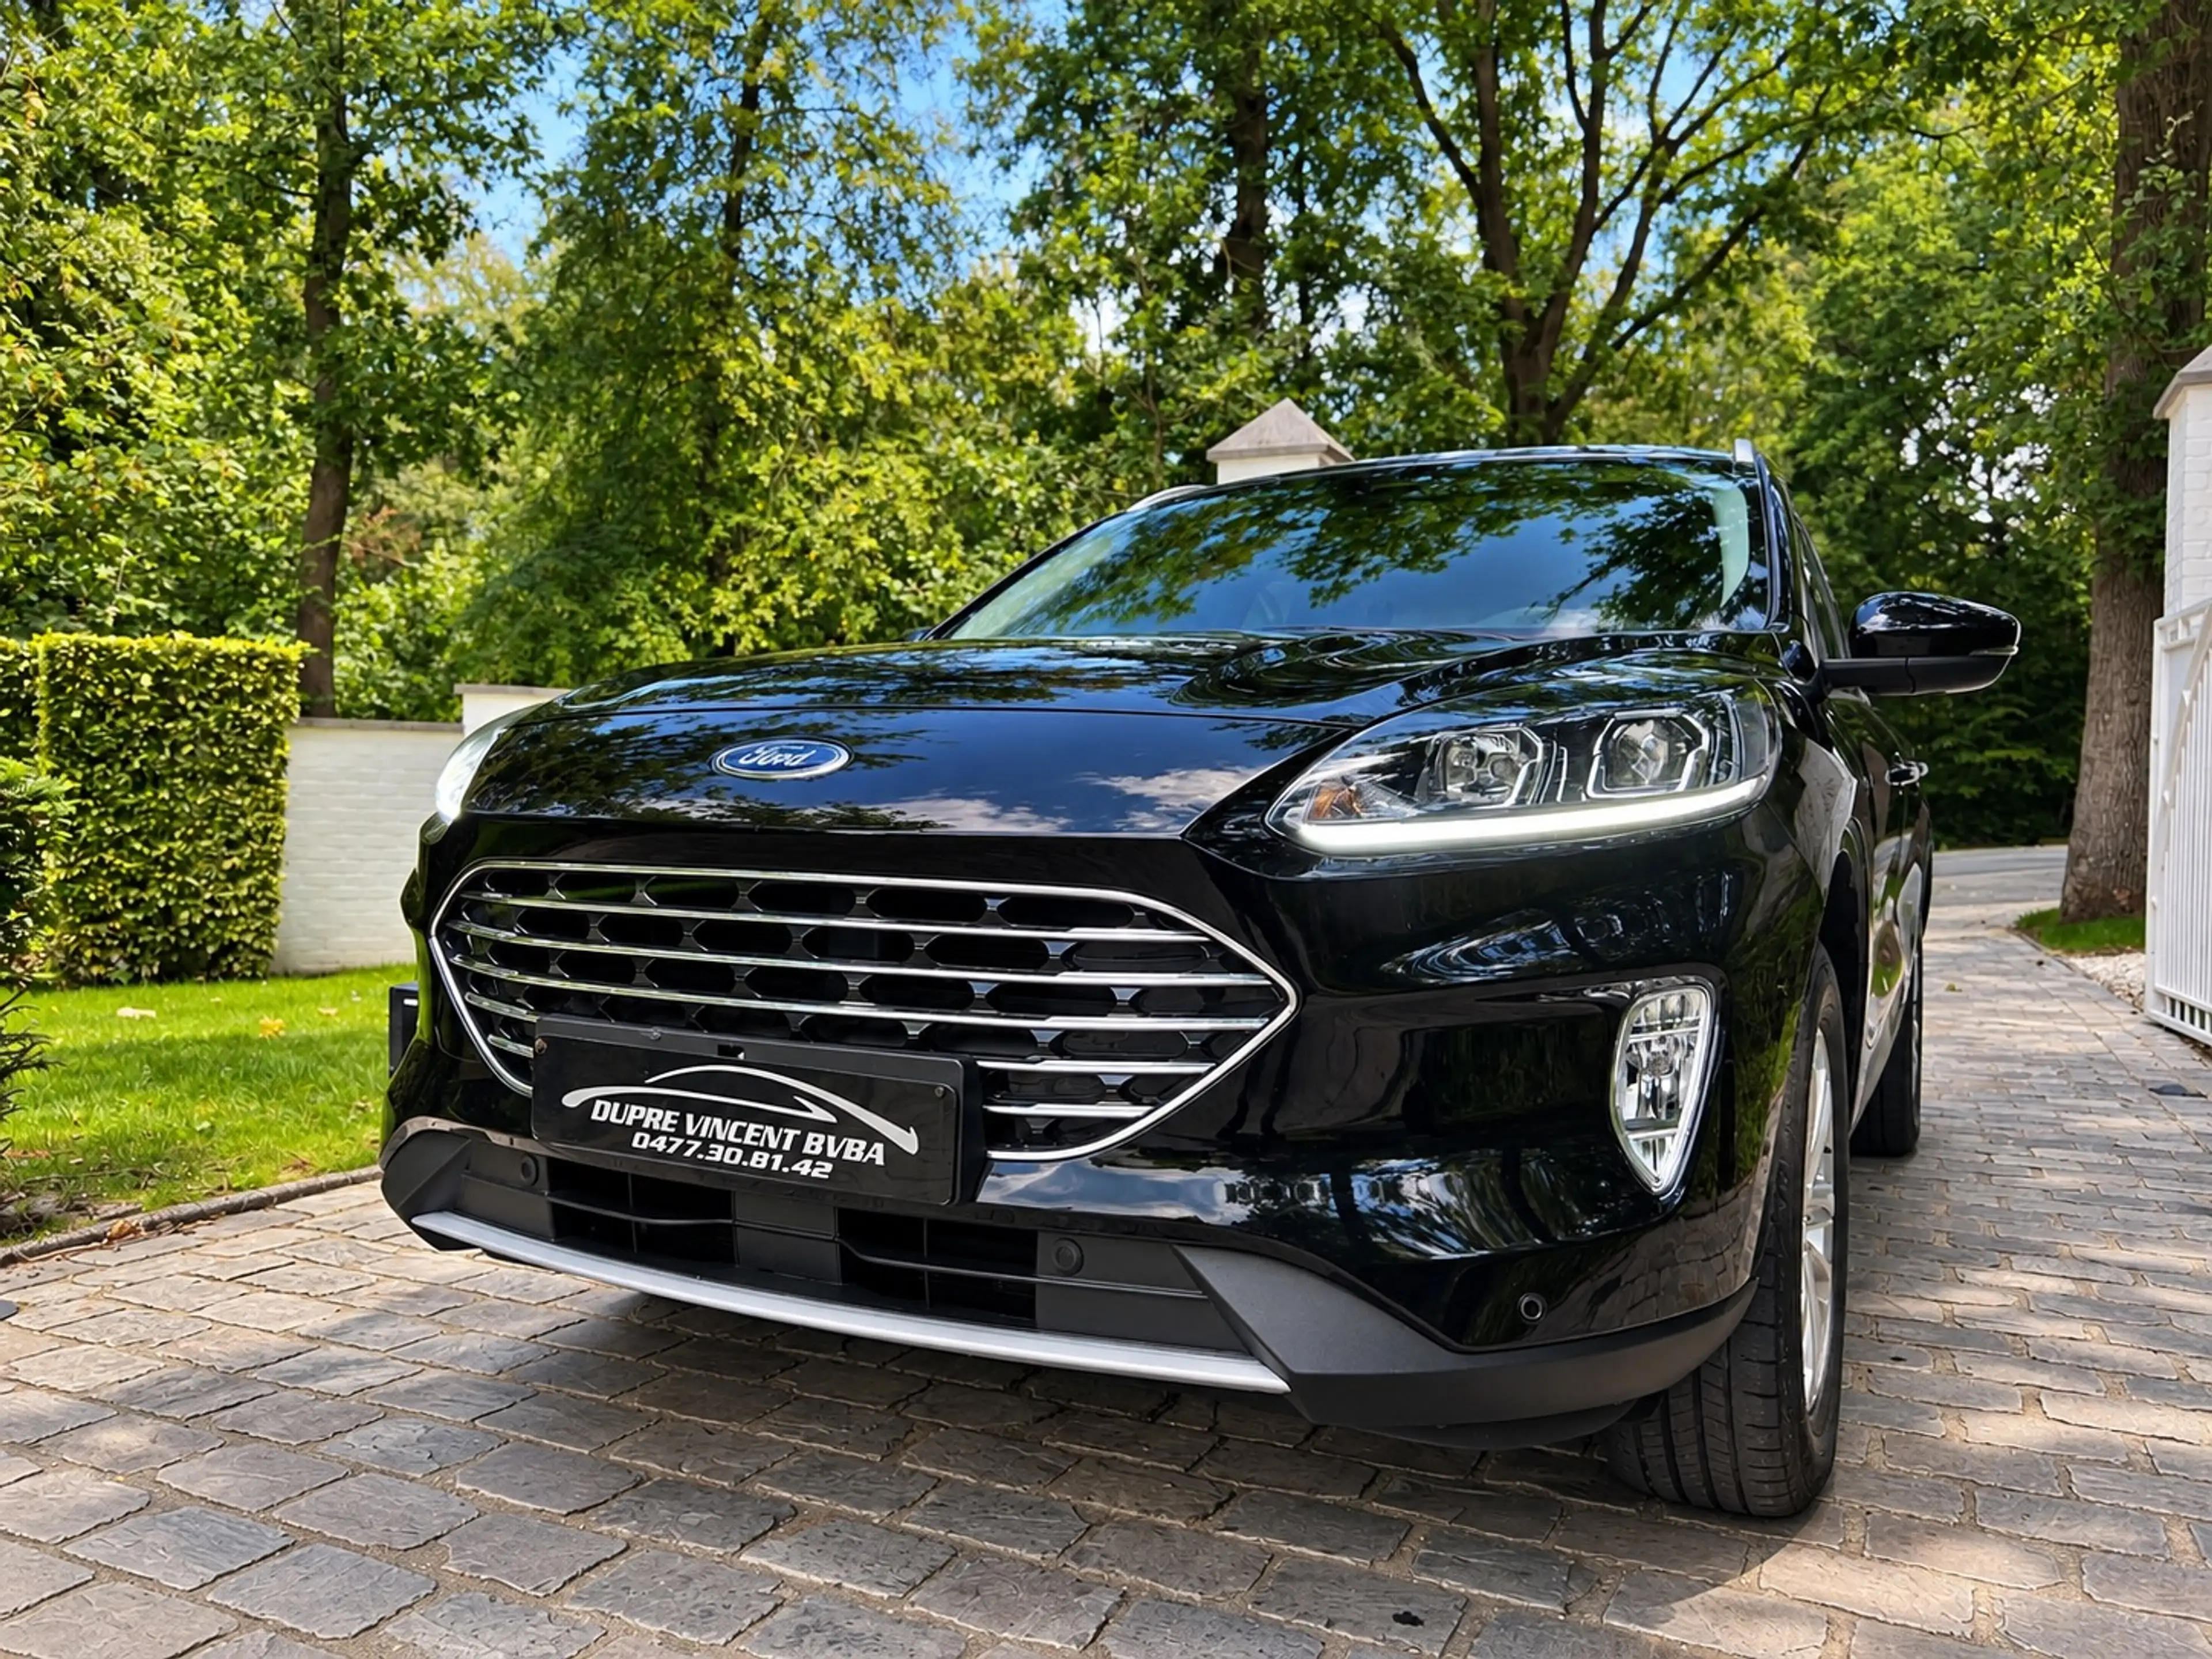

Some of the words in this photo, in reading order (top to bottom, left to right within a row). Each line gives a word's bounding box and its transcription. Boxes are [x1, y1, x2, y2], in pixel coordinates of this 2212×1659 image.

[739, 745, 816, 766] Ford
[590, 1099, 681, 1133] DUPRE
[685, 1113, 802, 1152] VINCENT
[802, 1131, 885, 1166] BVBA
[631, 1131, 834, 1179] 0477.30.81.42
